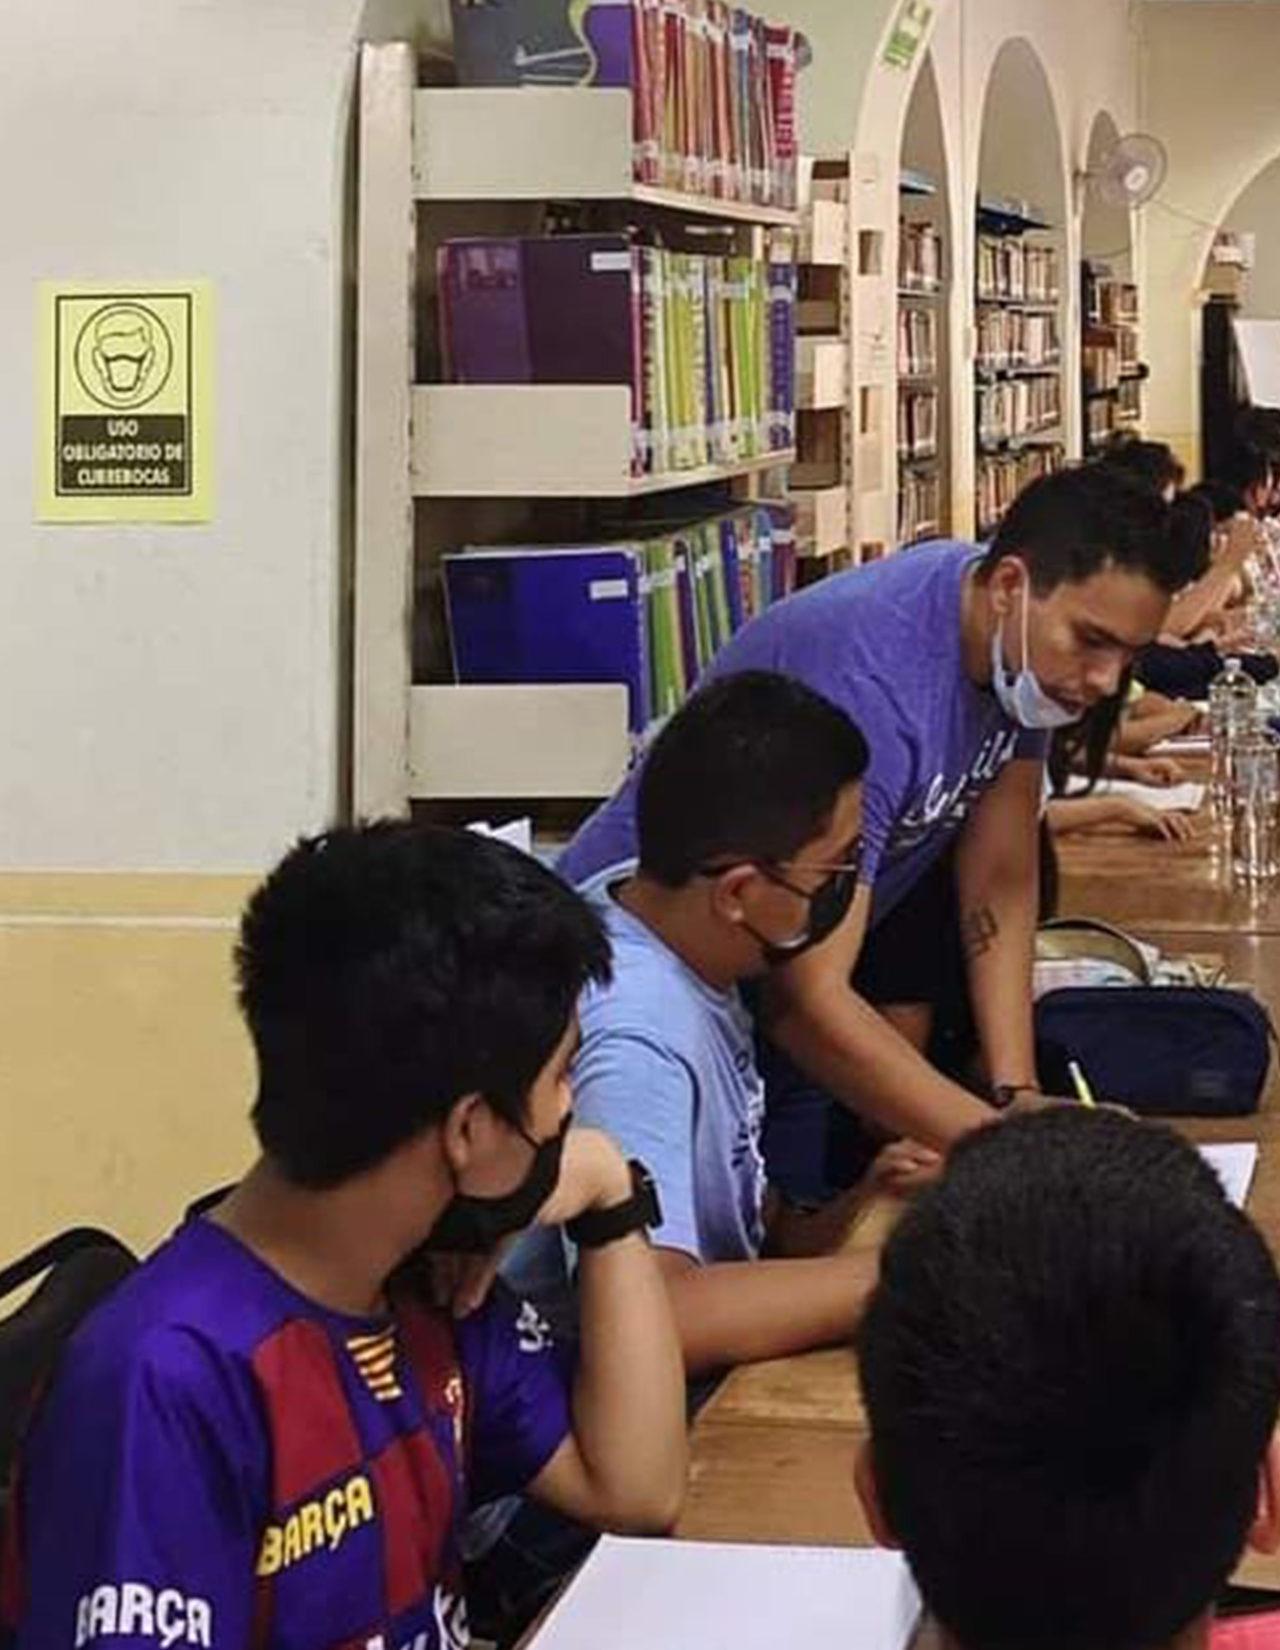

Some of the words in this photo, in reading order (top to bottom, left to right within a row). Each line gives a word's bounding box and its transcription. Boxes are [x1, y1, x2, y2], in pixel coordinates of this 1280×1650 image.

[107, 419, 139, 436] USO
[62, 442, 162, 462] OBLIGATORIO
[164, 443, 183, 461] DE
[77, 467, 170, 486] CUBREBOCAS
[256, 1476, 374, 1576] BARÇA
